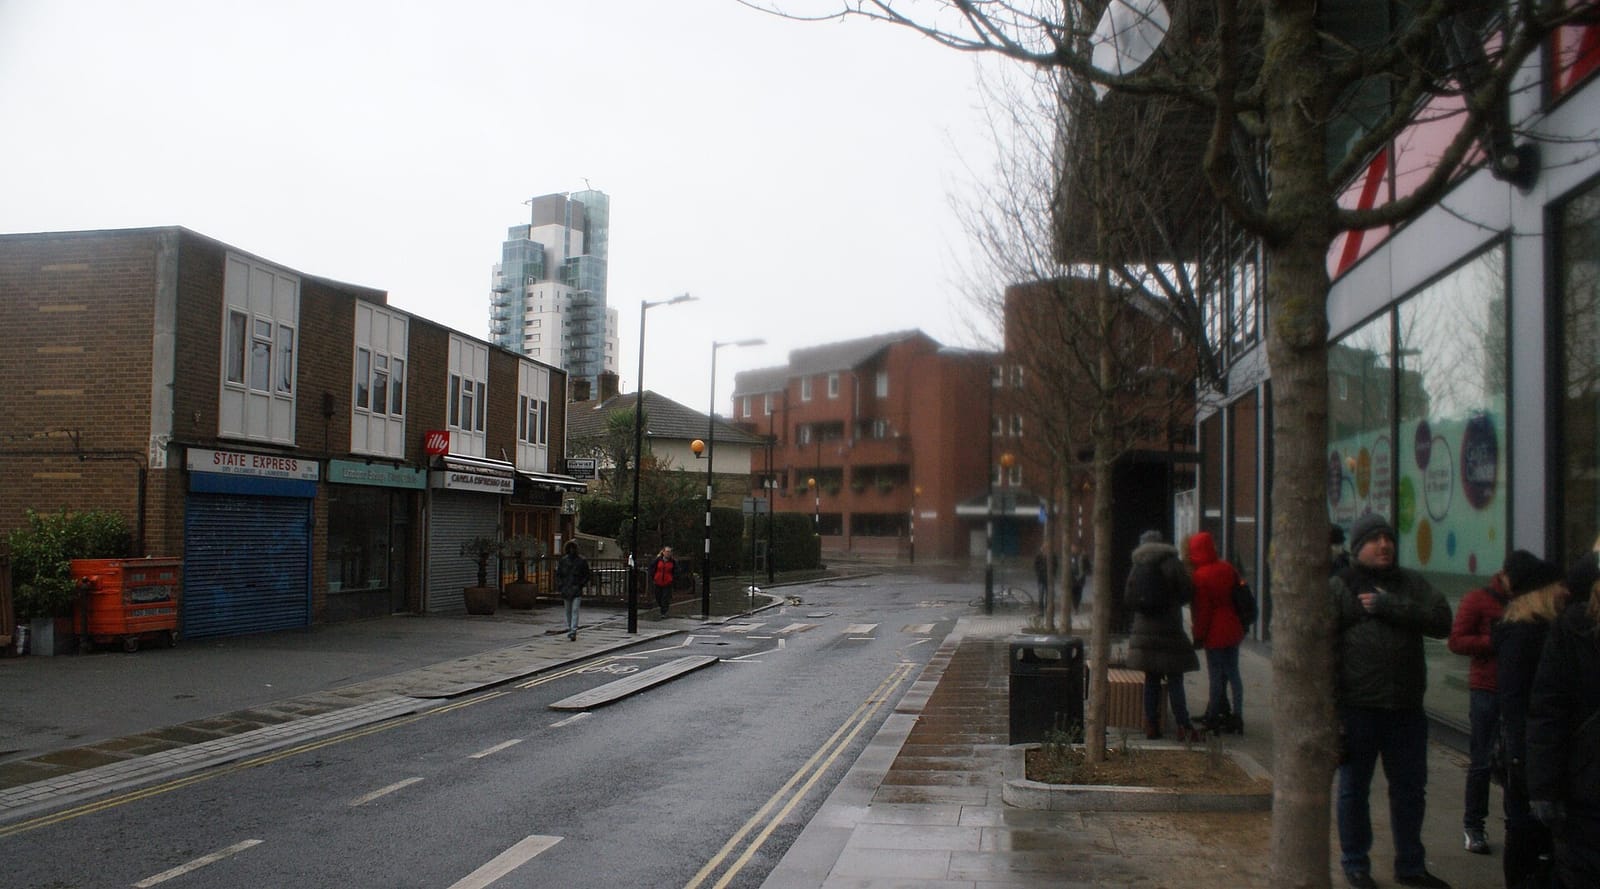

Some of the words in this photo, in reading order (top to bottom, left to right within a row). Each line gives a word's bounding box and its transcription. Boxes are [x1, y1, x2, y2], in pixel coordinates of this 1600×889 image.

[427, 433, 448, 452] illy
[213, 452, 246, 466] STATE
[252, 455, 298, 471] EXPRESS
